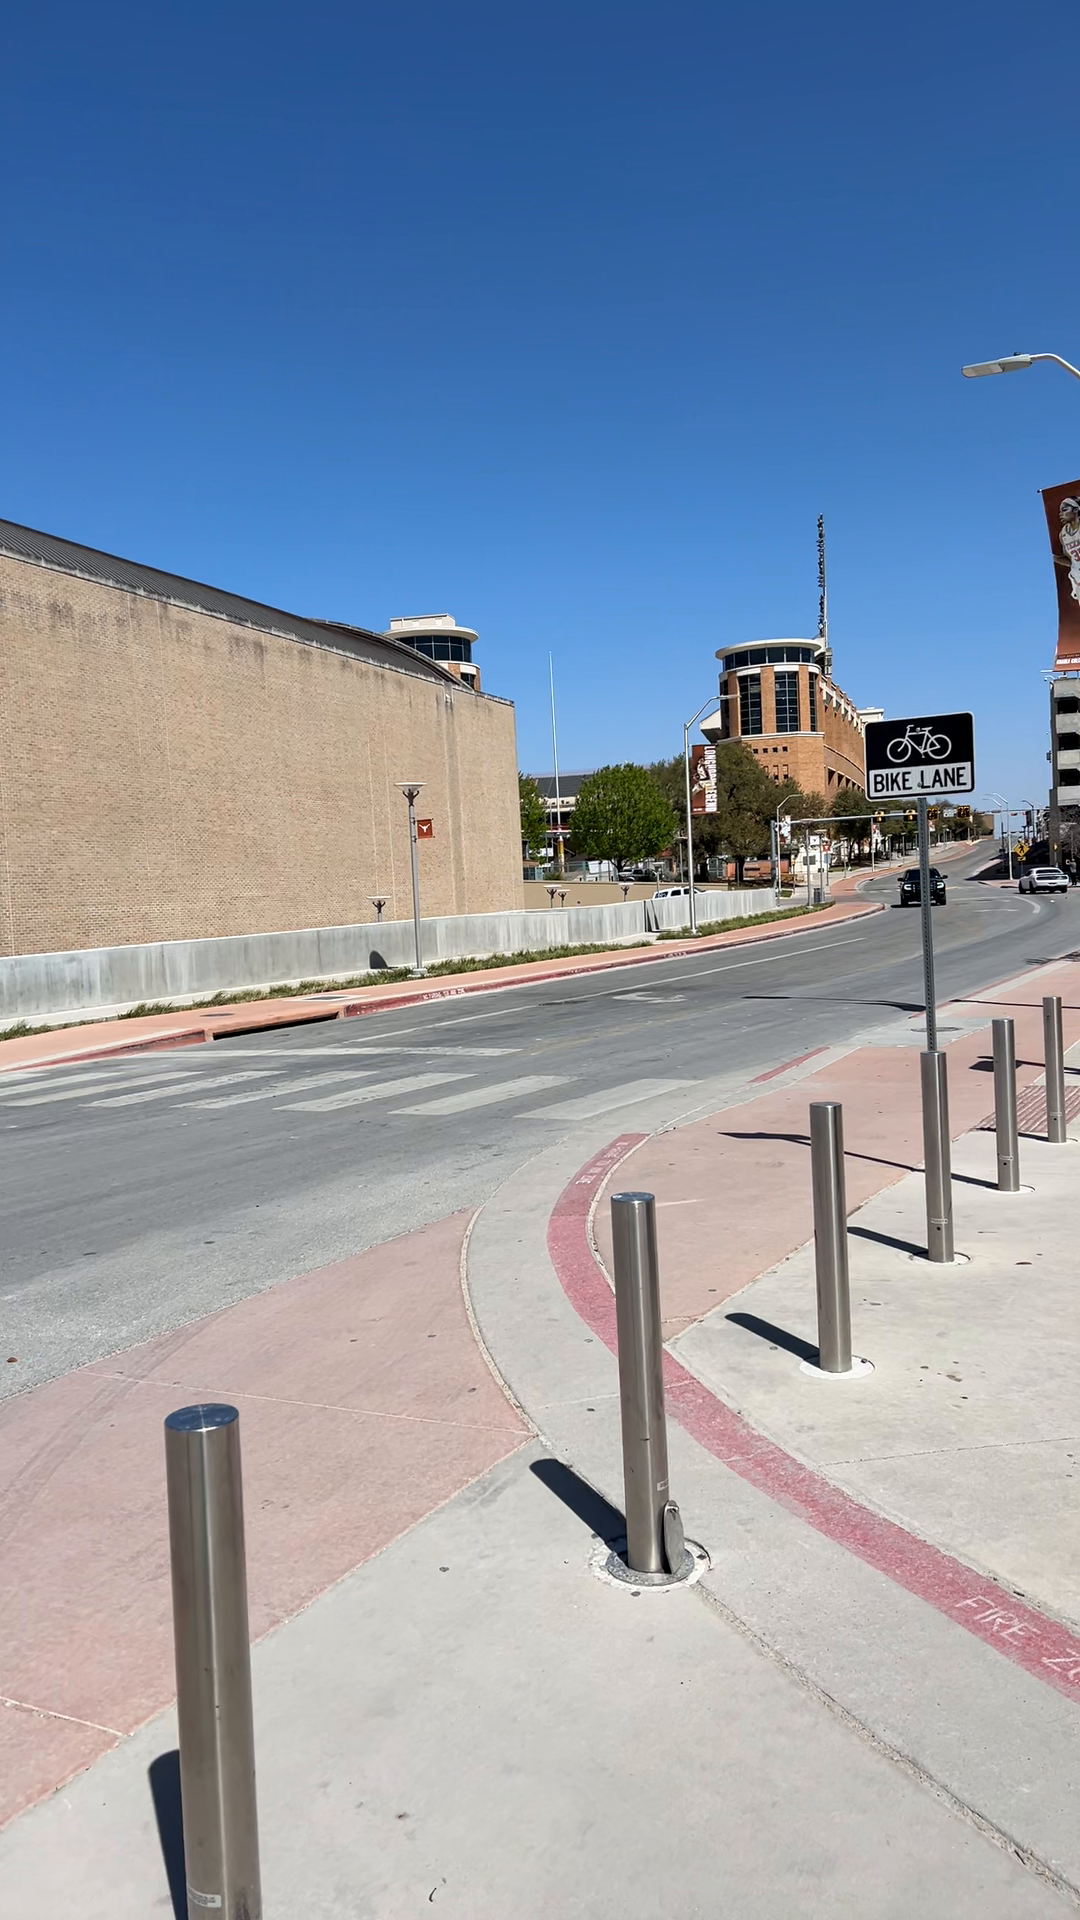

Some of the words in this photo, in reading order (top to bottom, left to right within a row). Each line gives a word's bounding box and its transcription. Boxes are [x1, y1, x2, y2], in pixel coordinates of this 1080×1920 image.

[873, 771, 913, 793] BIKE
[920, 767, 967, 789] LANE
[954, 1595, 1041, 1647] FIRE
